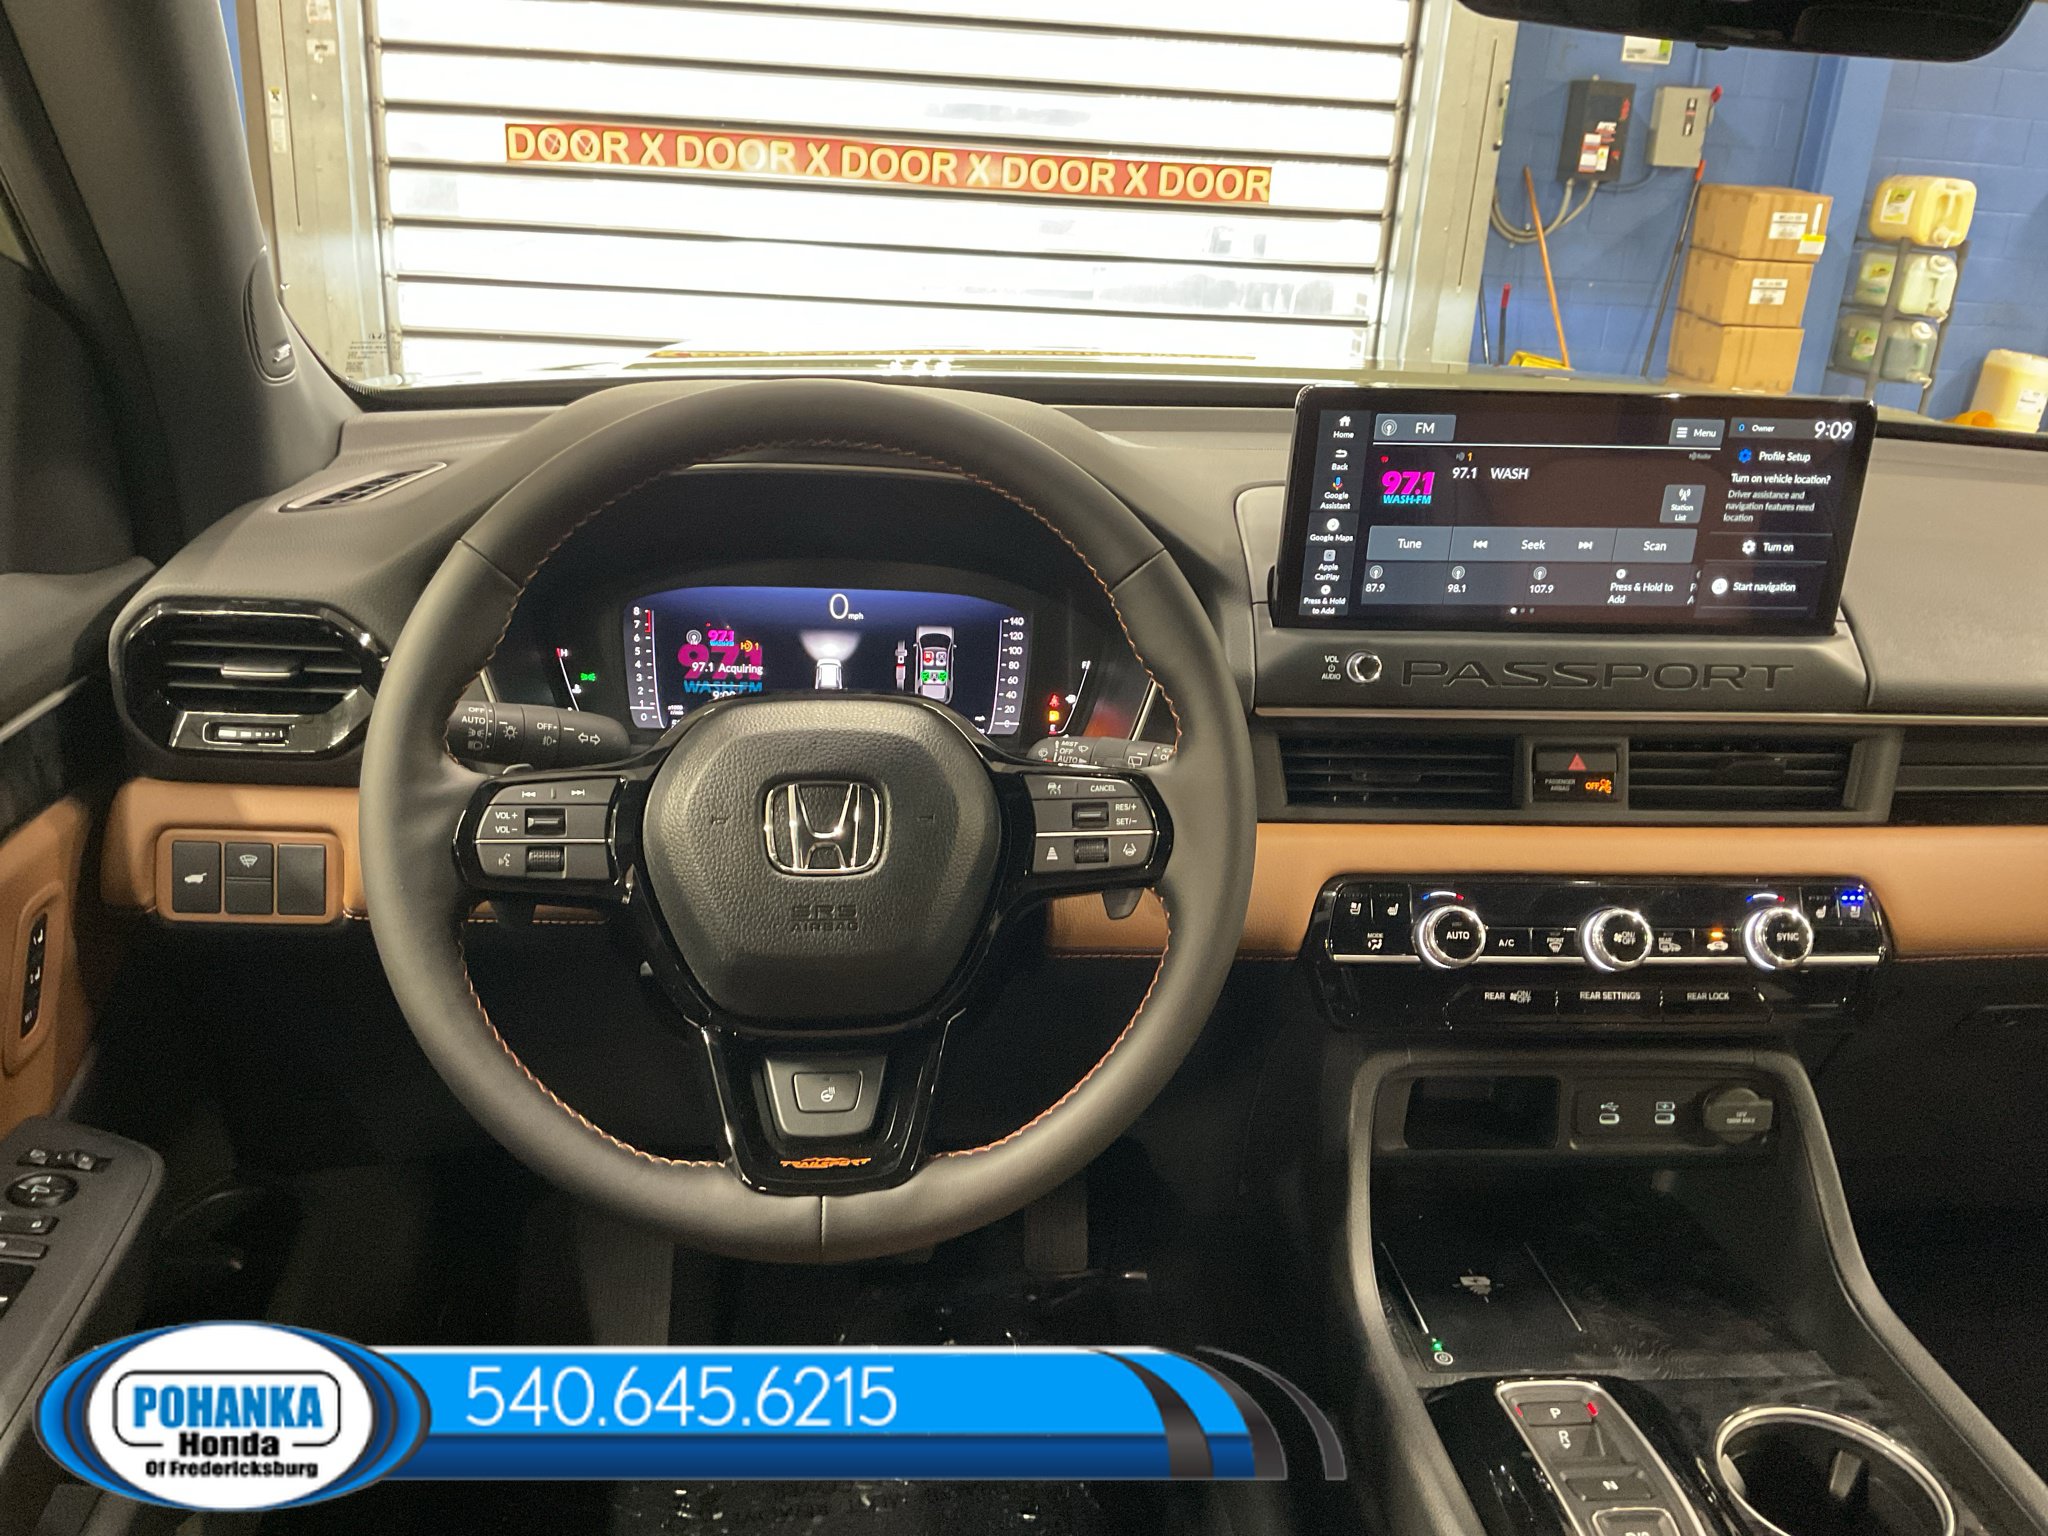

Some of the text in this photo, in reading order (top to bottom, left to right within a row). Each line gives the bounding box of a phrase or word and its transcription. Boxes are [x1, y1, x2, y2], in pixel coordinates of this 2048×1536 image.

[507, 126, 1271, 202] DOOR X DOOR X DOOR X DOOR X DOOR
[1415, 422, 1435, 433] FM
[1751, 424, 1775, 432] Owner
[1814, 421, 1852, 439] 9:09
[1693, 428, 1716, 438] Menu
[1759, 452, 1811, 463] Profile Setup
[1452, 467, 1529, 480] 97.1 WASH
[1381, 470, 1435, 495] 97.1
[1731, 473, 1831, 485] Turn on vehicle location?
[1324, 492, 1349, 500] Google
[1728, 490, 1805, 500] Driver assistance and
[1725, 502, 1815, 512] navigation features need
[1675, 514, 1687, 522] List
[1723, 514, 1754, 522] location
[1310, 534, 1353, 542] Google Maps
[1398, 539, 1422, 549] Tune
[1521, 540, 1546, 550] Seek
[1643, 541, 1667, 552] Scan
[1763, 542, 1794, 552] Turn on
[1318, 563, 1339, 571] Apple
[1314, 573, 1340, 581] CarPlay
[1365, 584, 1385, 593] 87.9
[1447, 584, 1467, 593] 98.1
[1529, 585, 1554, 594] 107.9
[1610, 583, 1674, 592] Press & Hold to
[1733, 582, 1796, 593] Start navigation
[1607, 595, 1626, 604] Add
[633, 607, 640, 615] 8
[829, 593, 864, 621] 0 mph
[1009, 617, 1024, 626] 140
[634, 634, 640, 642] 6
[708, 630, 734, 641] 97.1
[1009, 631, 1023, 640] 120
[1008, 646, 1022, 655] 100
[1325, 655, 1339, 664] VOL
[692, 662, 763, 675] 97.1 Acquiring
[1008, 661, 1019, 670] 80
[1007, 675, 1018, 685] 60
[1321, 673, 1341, 681] AUDIO
[1401, 660, 1795, 691] PASSPORT
[637, 687, 644, 695] 2
[1005, 690, 1017, 699] 40
[1004, 705, 1015, 713] 20
[461, 716, 486, 724] AUTO
[641, 713, 647, 721] 0
[1058, 755, 1078, 763] AUTO
[1585, 782, 1600, 790] OFF
[1446, 931, 1470, 940] AUTO
[1776, 932, 1799, 942] SYNC
[1499, 938, 1515, 947] A/C
[1484, 991, 1505, 1000] REAR
[1580, 991, 1641, 1000] REAR SETTINGS
[1687, 992, 1730, 1000] REAR LOCK
[1550, 1408, 1561, 1418] P
[1558, 1431, 1569, 1443] R
[1603, 1480, 1618, 1490] N
